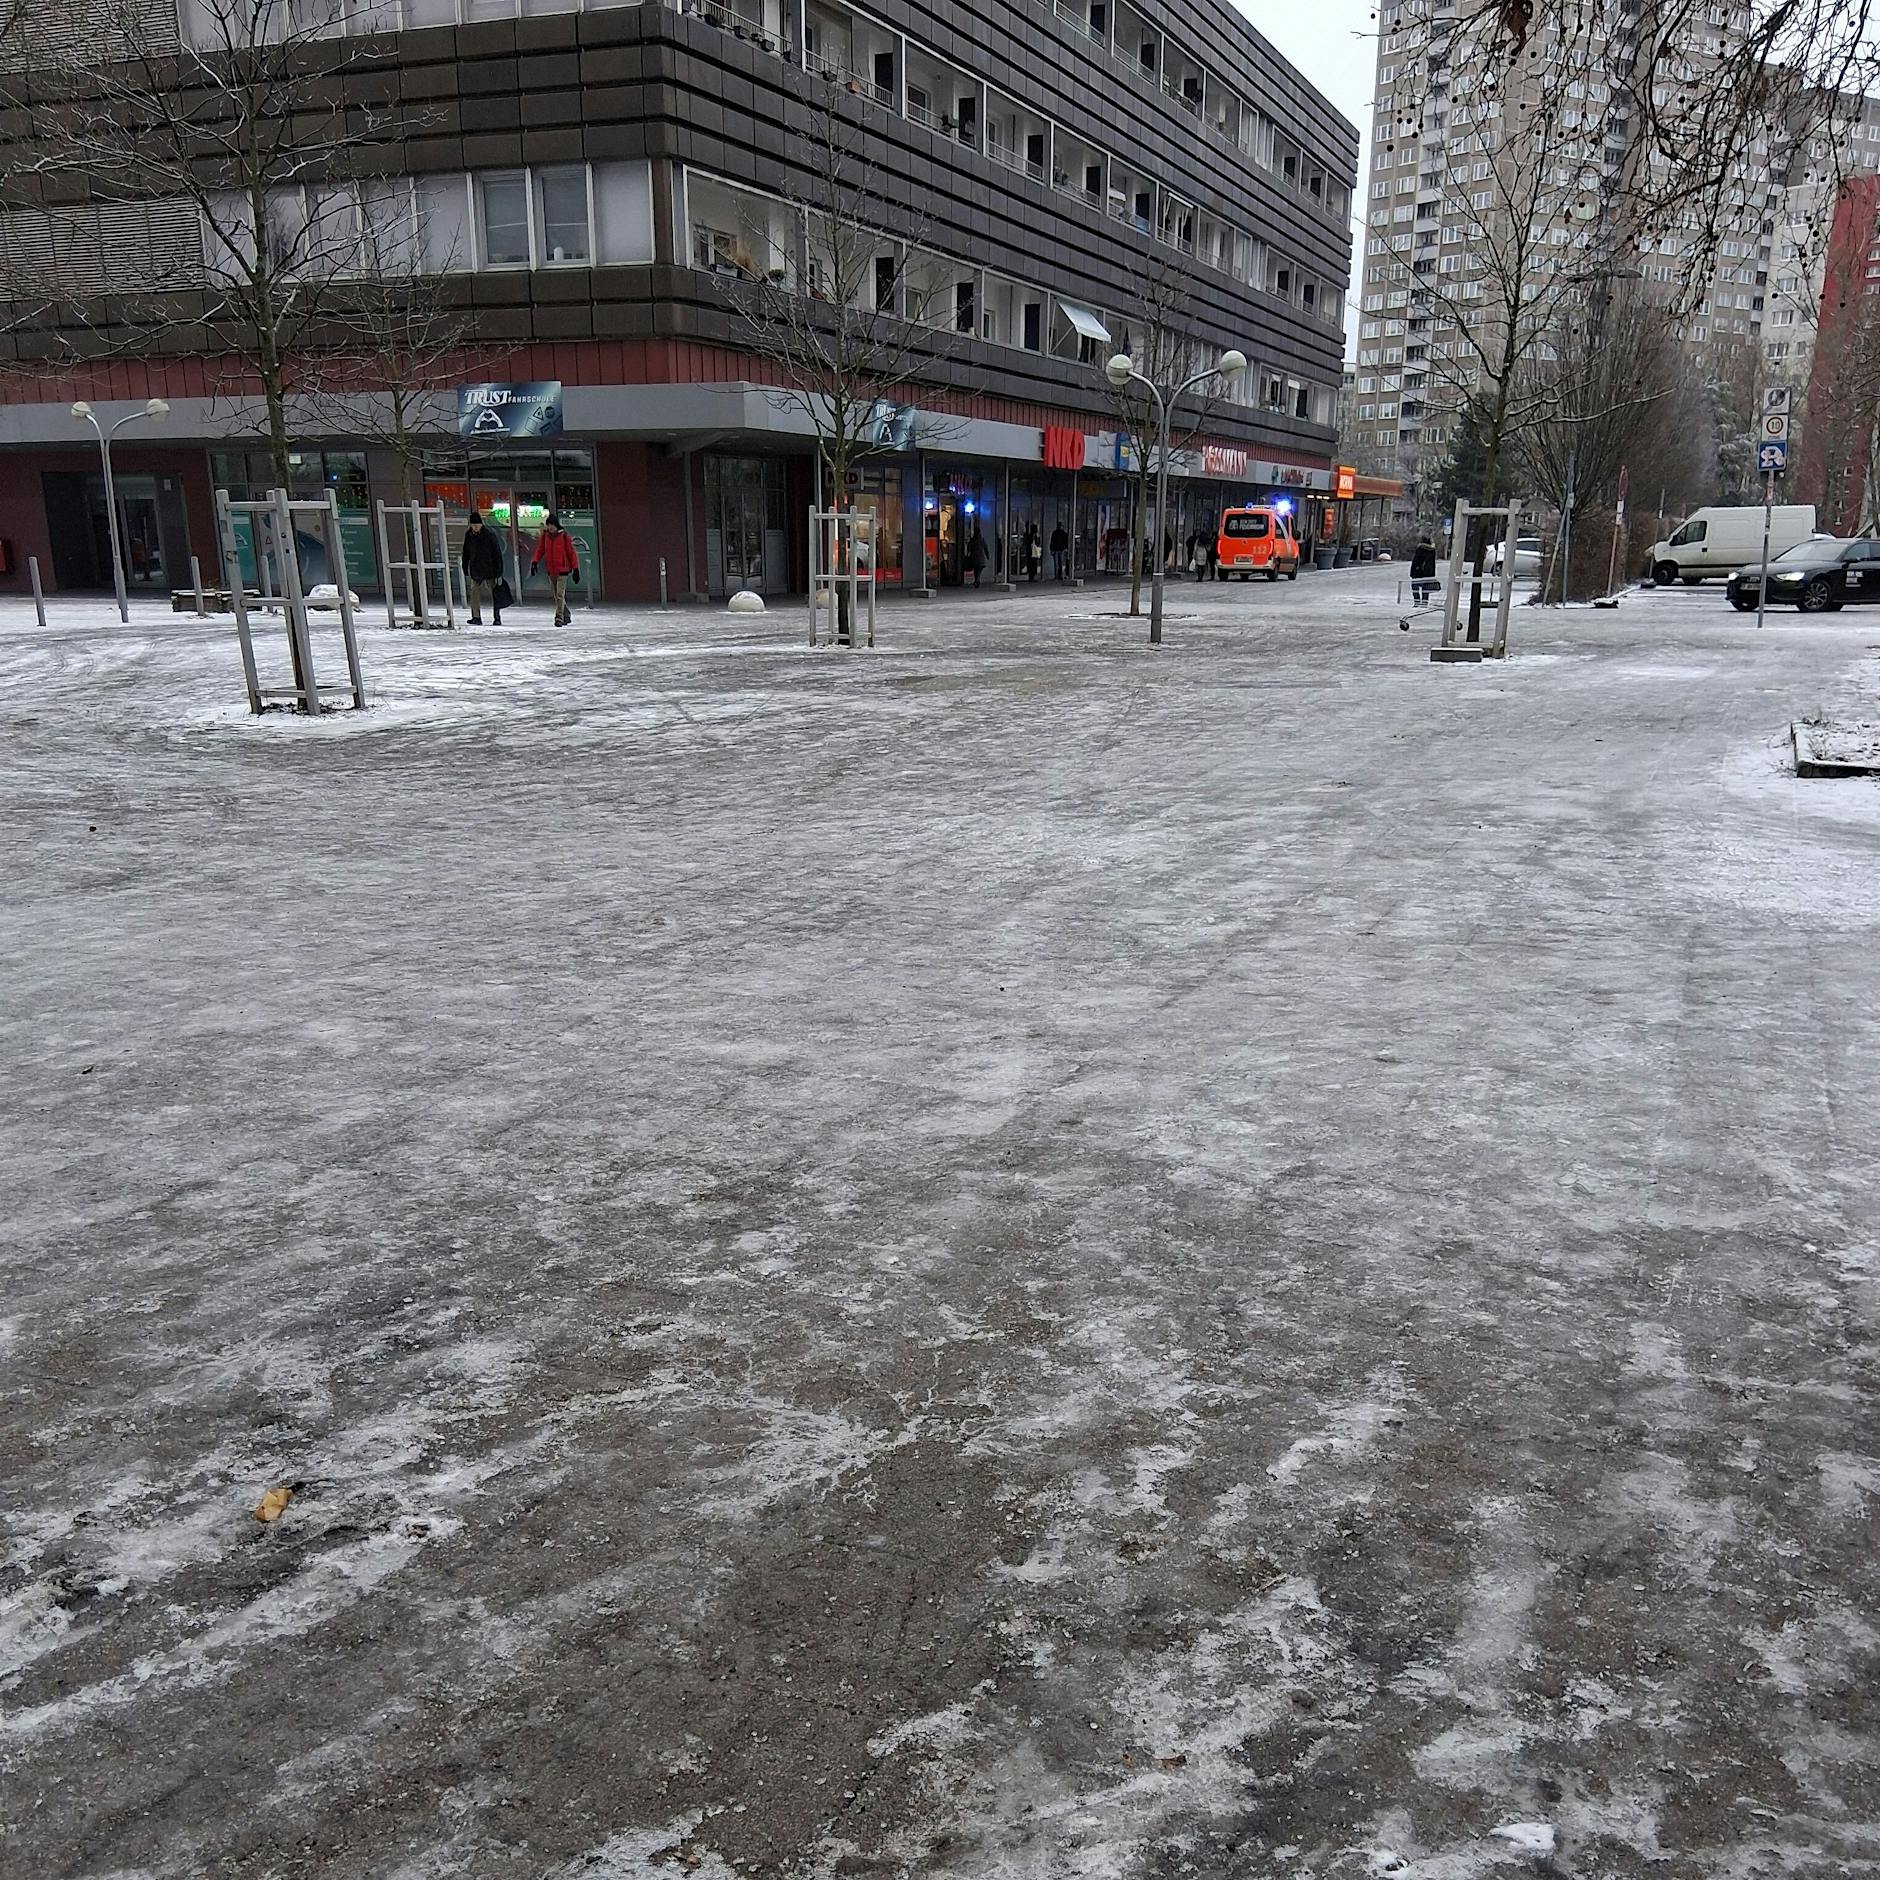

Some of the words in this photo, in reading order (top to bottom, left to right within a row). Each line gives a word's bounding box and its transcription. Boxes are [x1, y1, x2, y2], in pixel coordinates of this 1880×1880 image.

[465, 389, 511, 407] TRUST
[508, 396, 554, 404] FAHRSCHULE
[1771, 421, 1780, 431] 10
[1047, 427, 1085, 470] NKD
